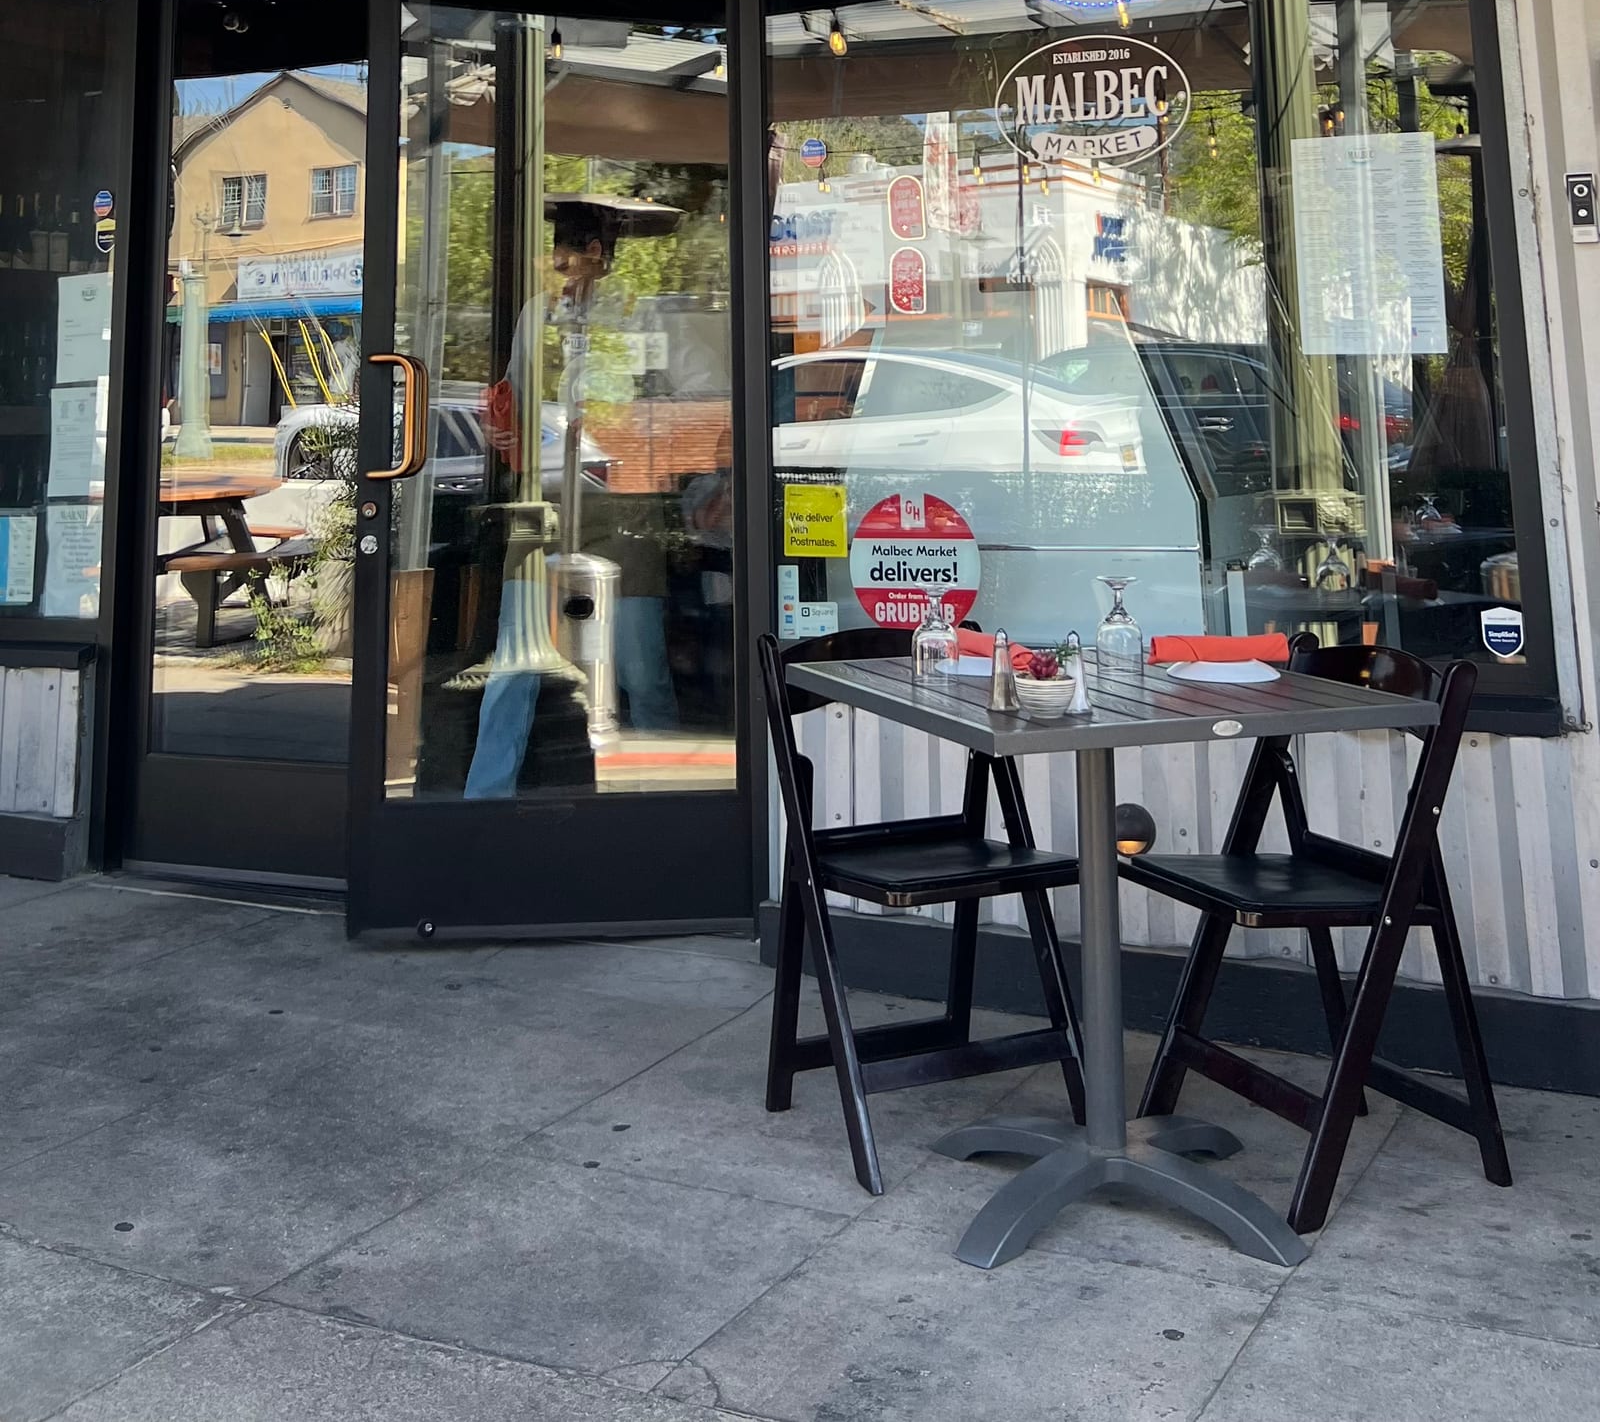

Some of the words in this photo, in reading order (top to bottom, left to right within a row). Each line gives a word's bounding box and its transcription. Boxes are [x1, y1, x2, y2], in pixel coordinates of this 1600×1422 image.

[1052, 50, 1107, 65] ESTABLISHED
[1108, 48, 1130, 61] 2016
[1014, 65, 1169, 126] MALBEC
[1045, 130, 1142, 157] MARKET
[790, 512, 804, 522] We
[805, 512, 834, 523] deliver
[790, 526, 809, 534] with
[790, 536, 838, 548] Postmates.
[871, 545, 913, 557] Malbec
[916, 545, 958, 557] Market
[870, 560, 959, 583] delivers!
[888, 592, 907, 600] Order
